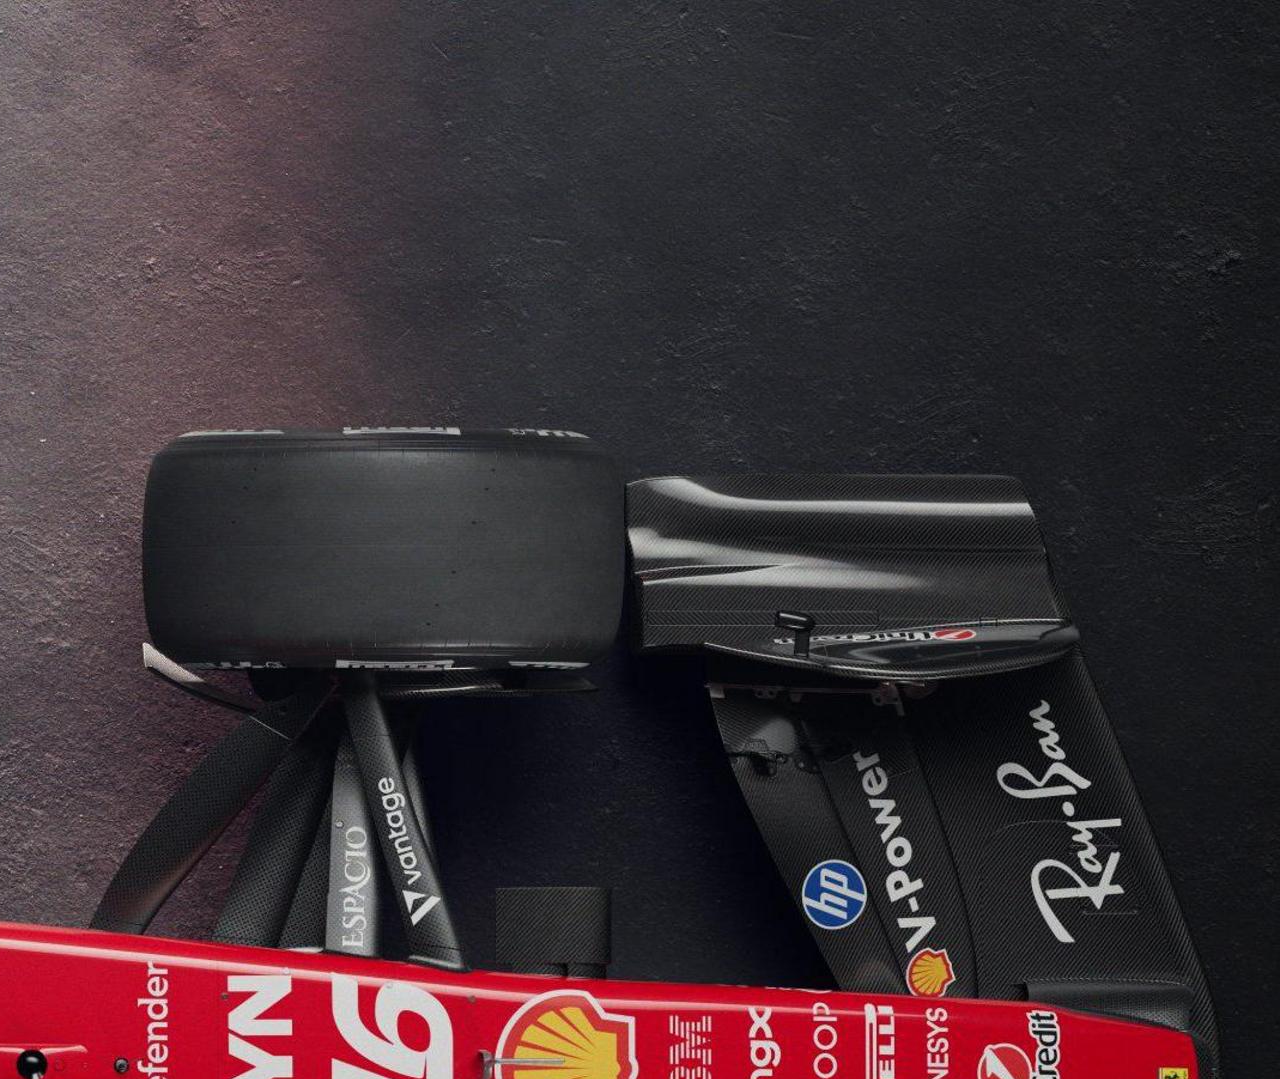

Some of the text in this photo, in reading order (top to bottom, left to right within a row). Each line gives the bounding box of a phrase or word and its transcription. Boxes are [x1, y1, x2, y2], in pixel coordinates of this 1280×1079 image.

[342, 824, 371, 949] ESPACIO
[378, 776, 424, 885] vantage
[850, 749, 937, 954] V-Power
[803, 867, 868, 920] hp
